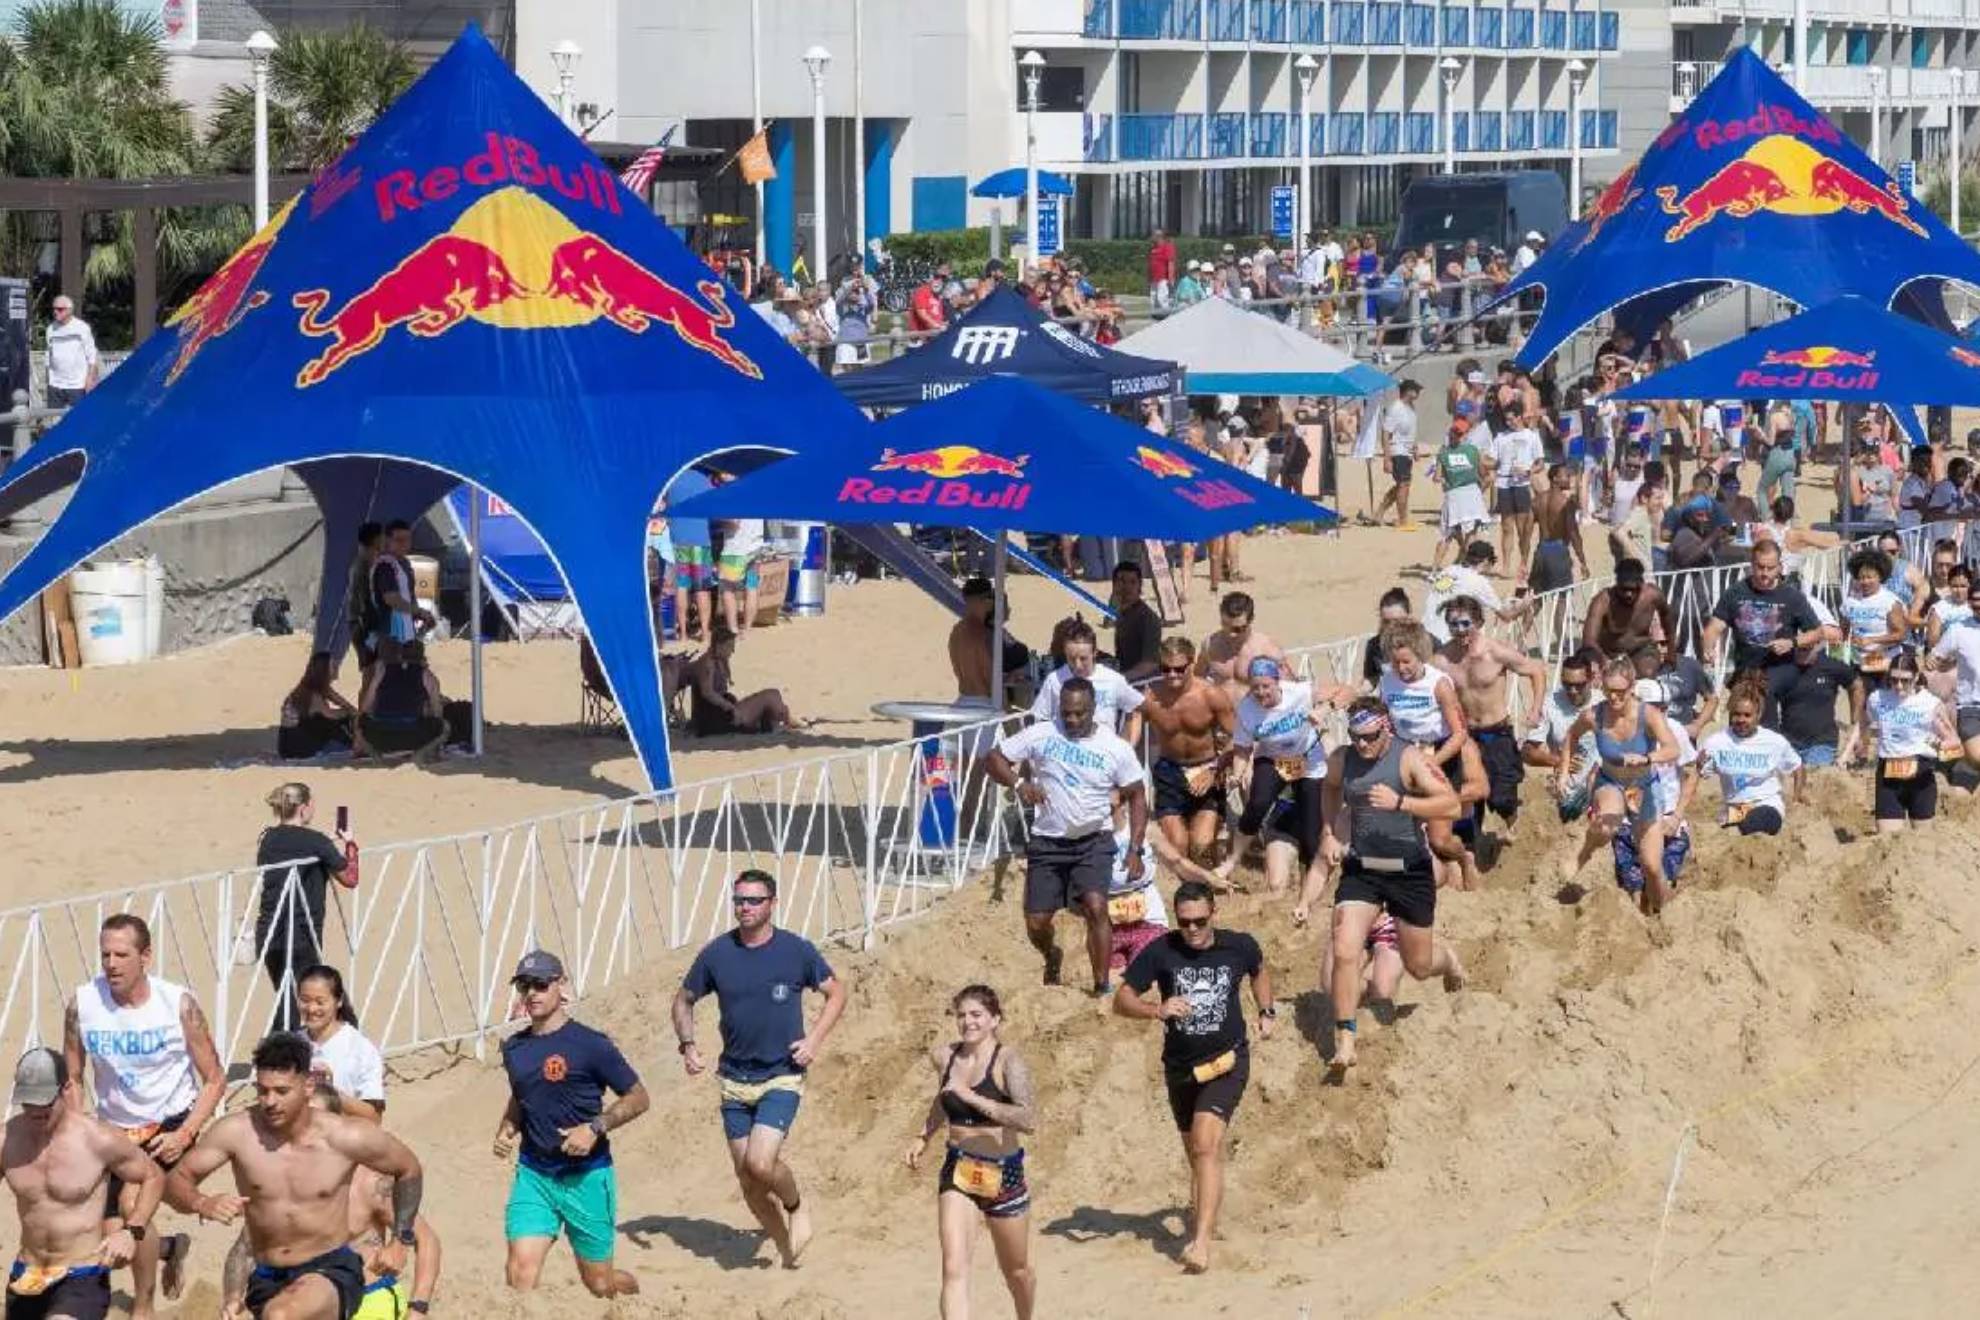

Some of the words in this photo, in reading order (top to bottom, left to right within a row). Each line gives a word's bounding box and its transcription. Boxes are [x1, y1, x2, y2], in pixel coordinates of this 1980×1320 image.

[1735, 370, 1806, 388] Red
[1809, 371, 1880, 389] Bull
[838, 476, 936, 503] Red
[936, 480, 1032, 511] Bull
